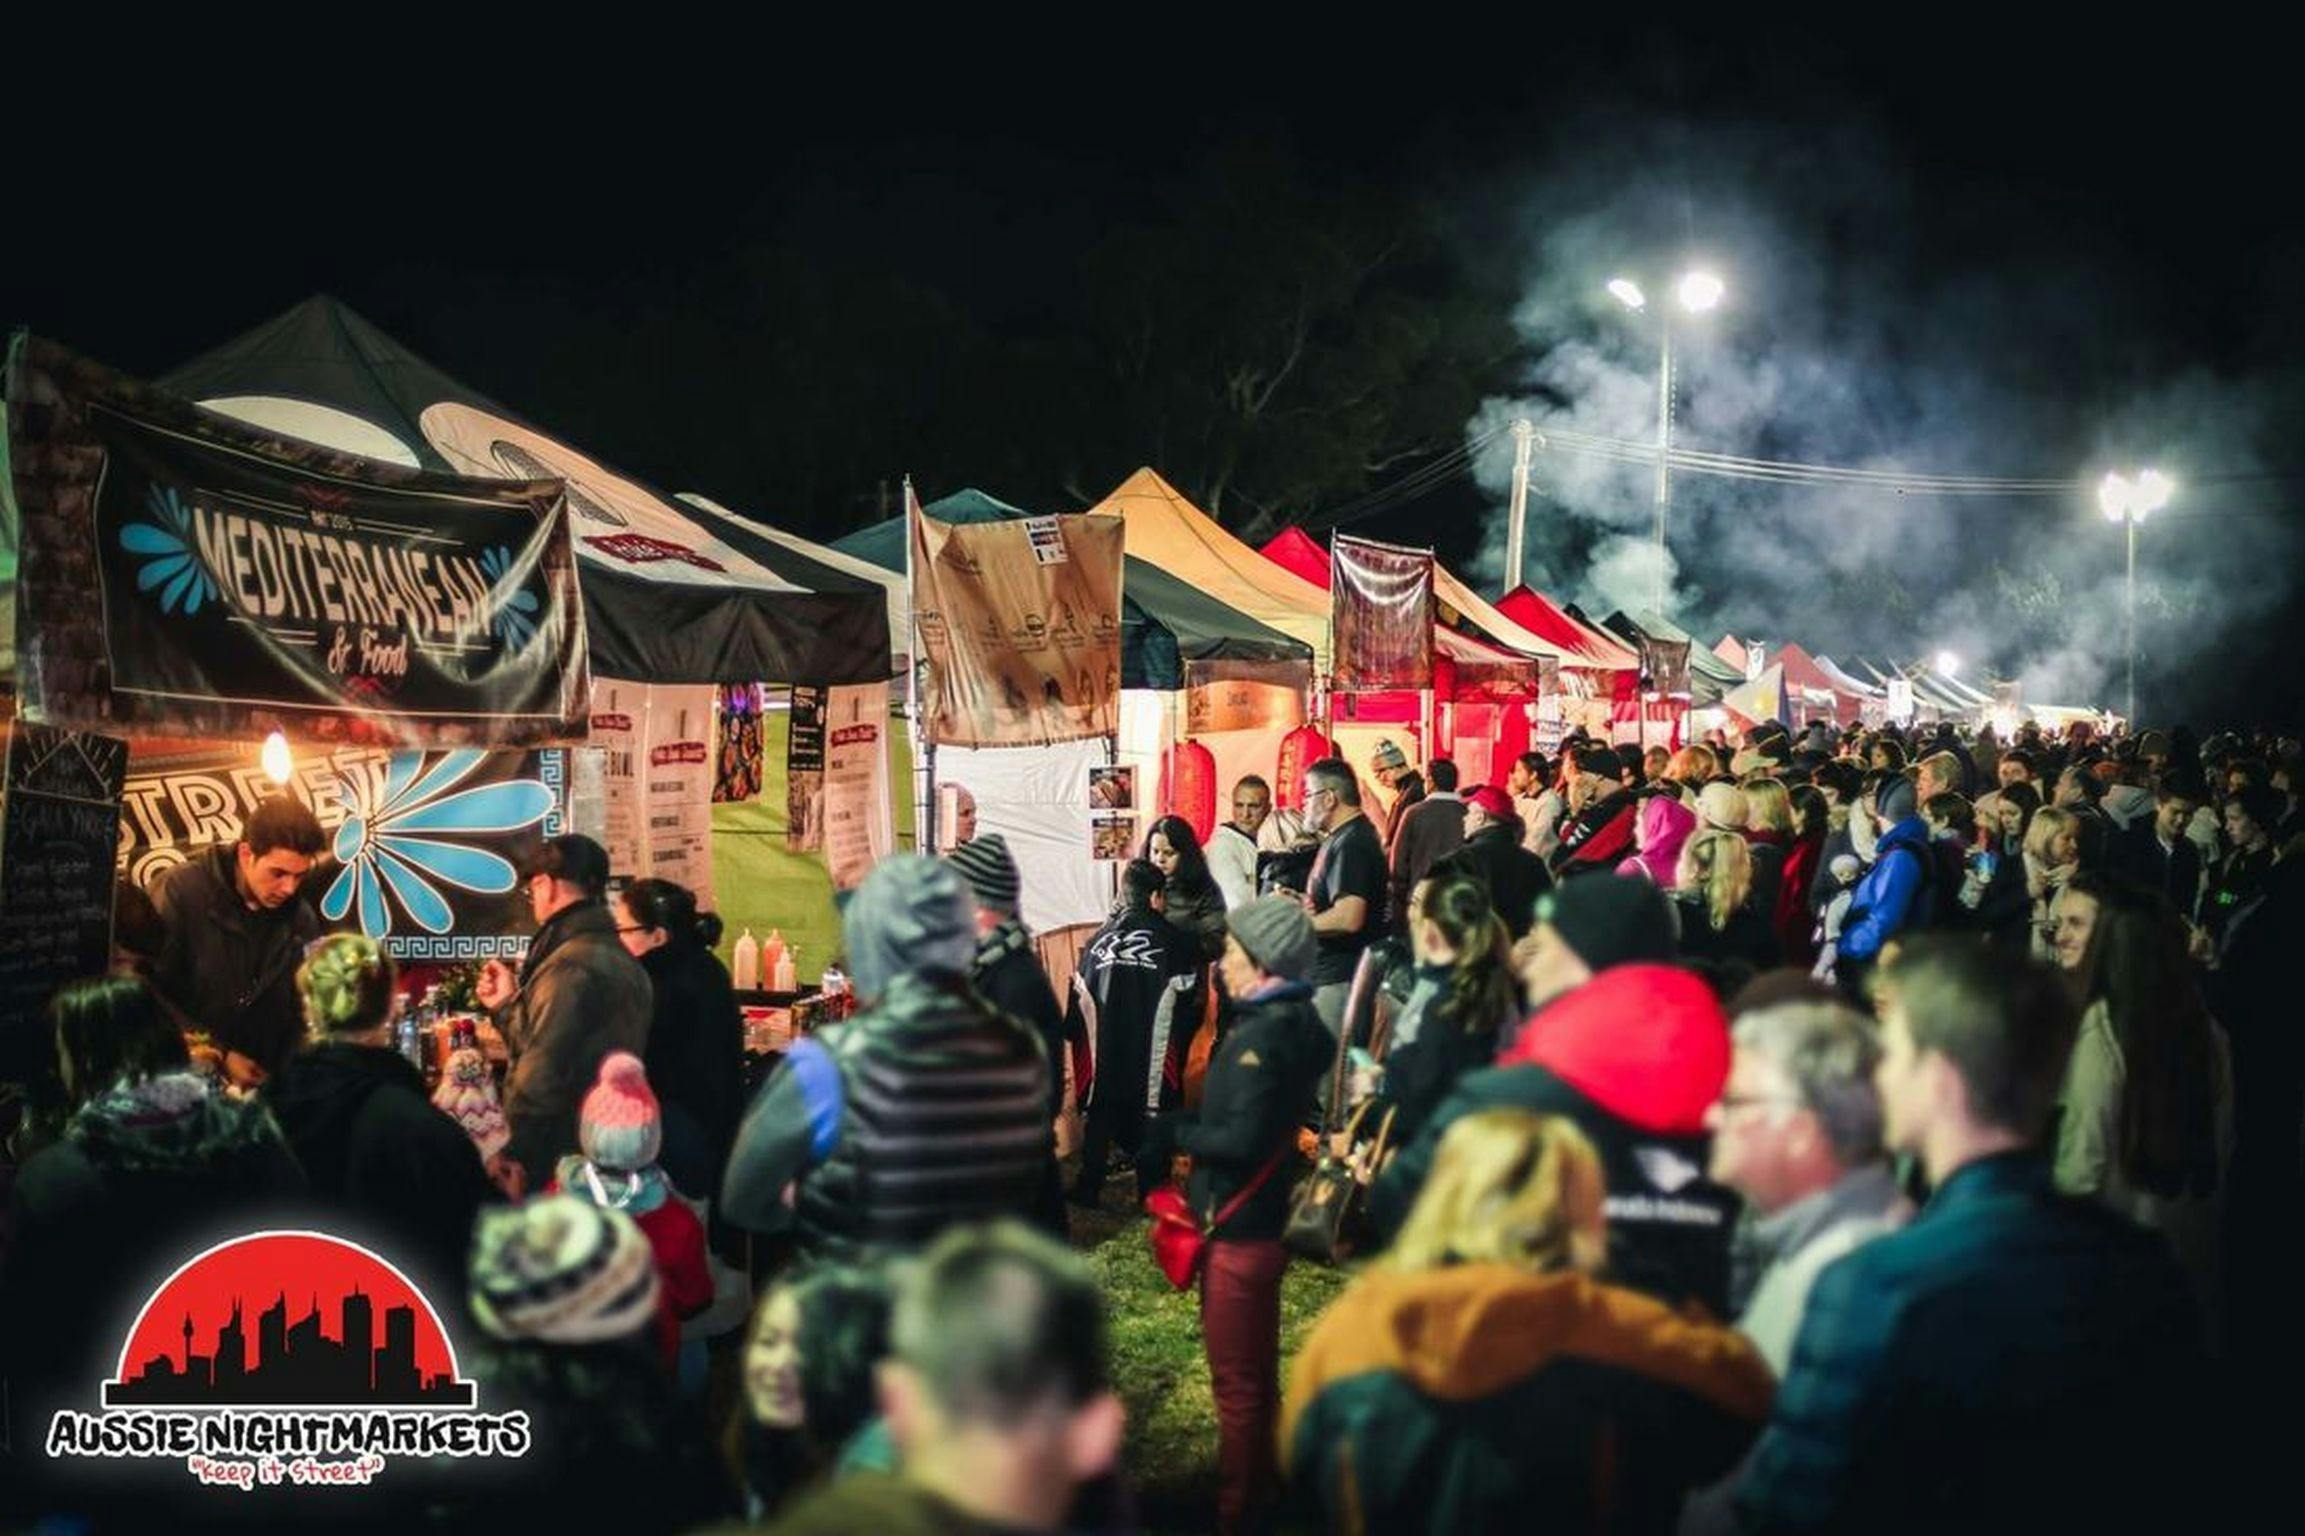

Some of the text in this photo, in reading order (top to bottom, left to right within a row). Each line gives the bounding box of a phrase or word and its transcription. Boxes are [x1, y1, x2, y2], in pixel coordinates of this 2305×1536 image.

[194, 507, 490, 636] MEDITERRANEAN
[327, 627, 409, 675] & Food
